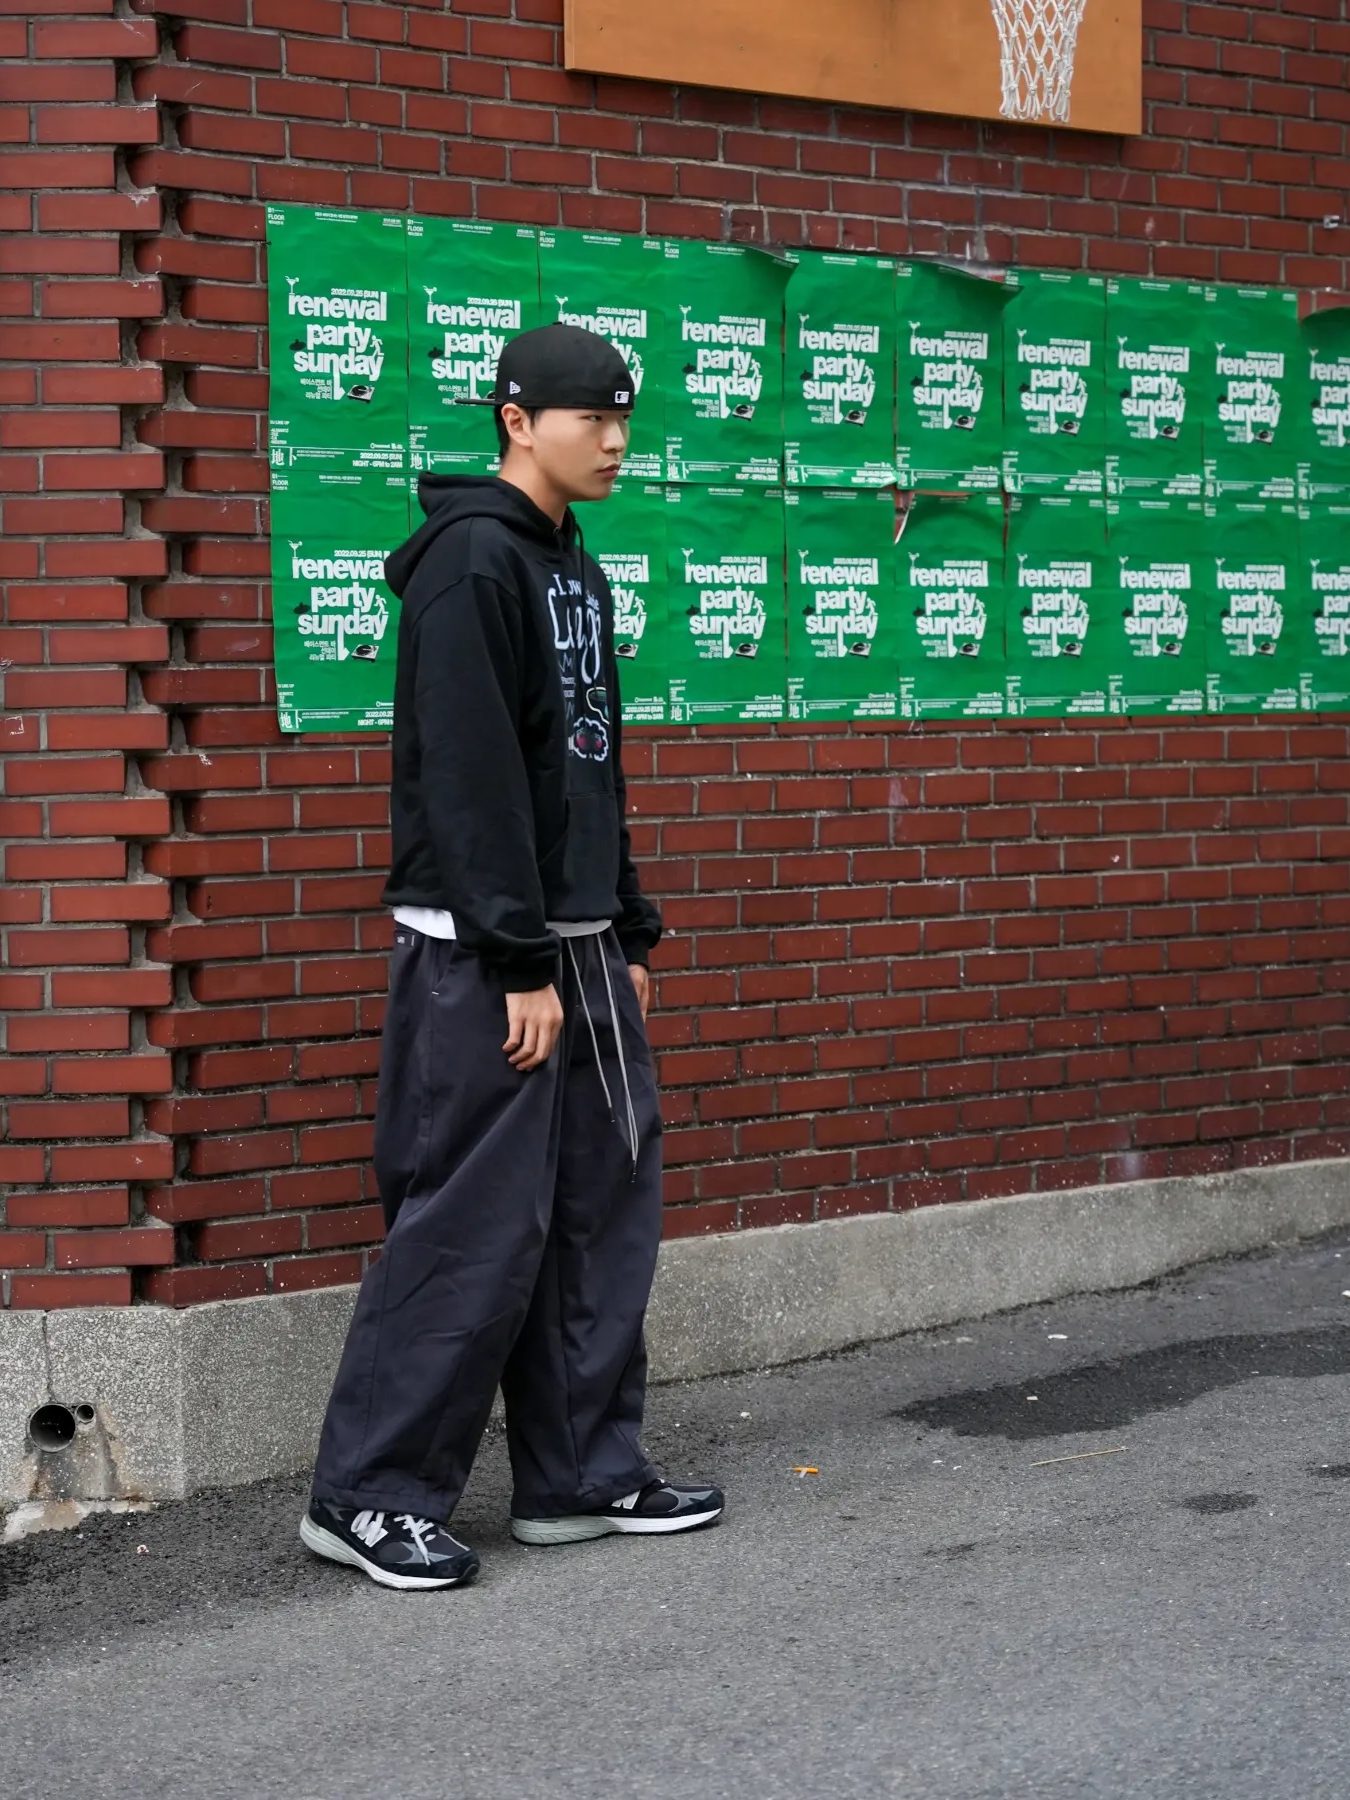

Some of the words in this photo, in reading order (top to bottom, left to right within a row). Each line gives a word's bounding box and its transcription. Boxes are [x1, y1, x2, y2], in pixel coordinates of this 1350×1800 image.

[288, 292, 387, 321] renewal
[427, 300, 520, 329] renewal
[306, 321, 372, 353] party
[444, 329, 505, 360] party
[682, 318, 766, 346] renewal
[799, 326, 879, 353] renewal
[910, 333, 988, 360] renewal
[1018, 340, 1091, 366] renewal
[1118, 347, 1190, 372] renewal
[294, 347, 384, 382] sunday
[432, 354, 498, 382] sunda
[697, 346, 752, 375] party
[814, 353, 864, 381] party
[923, 360, 975, 387] party
[1216, 353, 1284, 378] renewal
[1310, 362, 1350, 382] rene
[686, 371, 762, 401] sunday
[803, 378, 875, 407] sunday
[1031, 366, 1078, 392] party
[1131, 372, 1178, 399] party
[1228, 378, 1272, 403] party
[914, 384, 983, 412] sunday
[1021, 390, 1088, 418] sunday
[1121, 396, 1186, 423] sunday
[1320, 386, 1350, 407] par
[1218, 400, 1281, 428] sunday
[292, 550, 390, 580] renewa
[685, 557, 767, 584] renewal
[801, 558, 878, 585] renewal
[910, 561, 988, 587] renewal
[1018, 562, 1091, 588] renewal
[1120, 563, 1191, 589] renewal
[1217, 565, 1285, 590] renewal
[1312, 572, 1350, 590] rene
[311, 582, 376, 613] party
[700, 585, 755, 614] party
[815, 586, 867, 614] party
[925, 588, 976, 616] party
[1032, 589, 1080, 615] party
[1133, 590, 1180, 616] party
[1230, 591, 1275, 616] party
[1324, 596, 1350, 616] par
[298, 608, 389, 640] sunday
[690, 609, 766, 640] sunday
[806, 610, 878, 639] sunday
[916, 611, 986, 640] sunday
[1023, 611, 1089, 640] sunday
[1124, 613, 1188, 639] sunday
[1222, 613, 1283, 639] sunday
